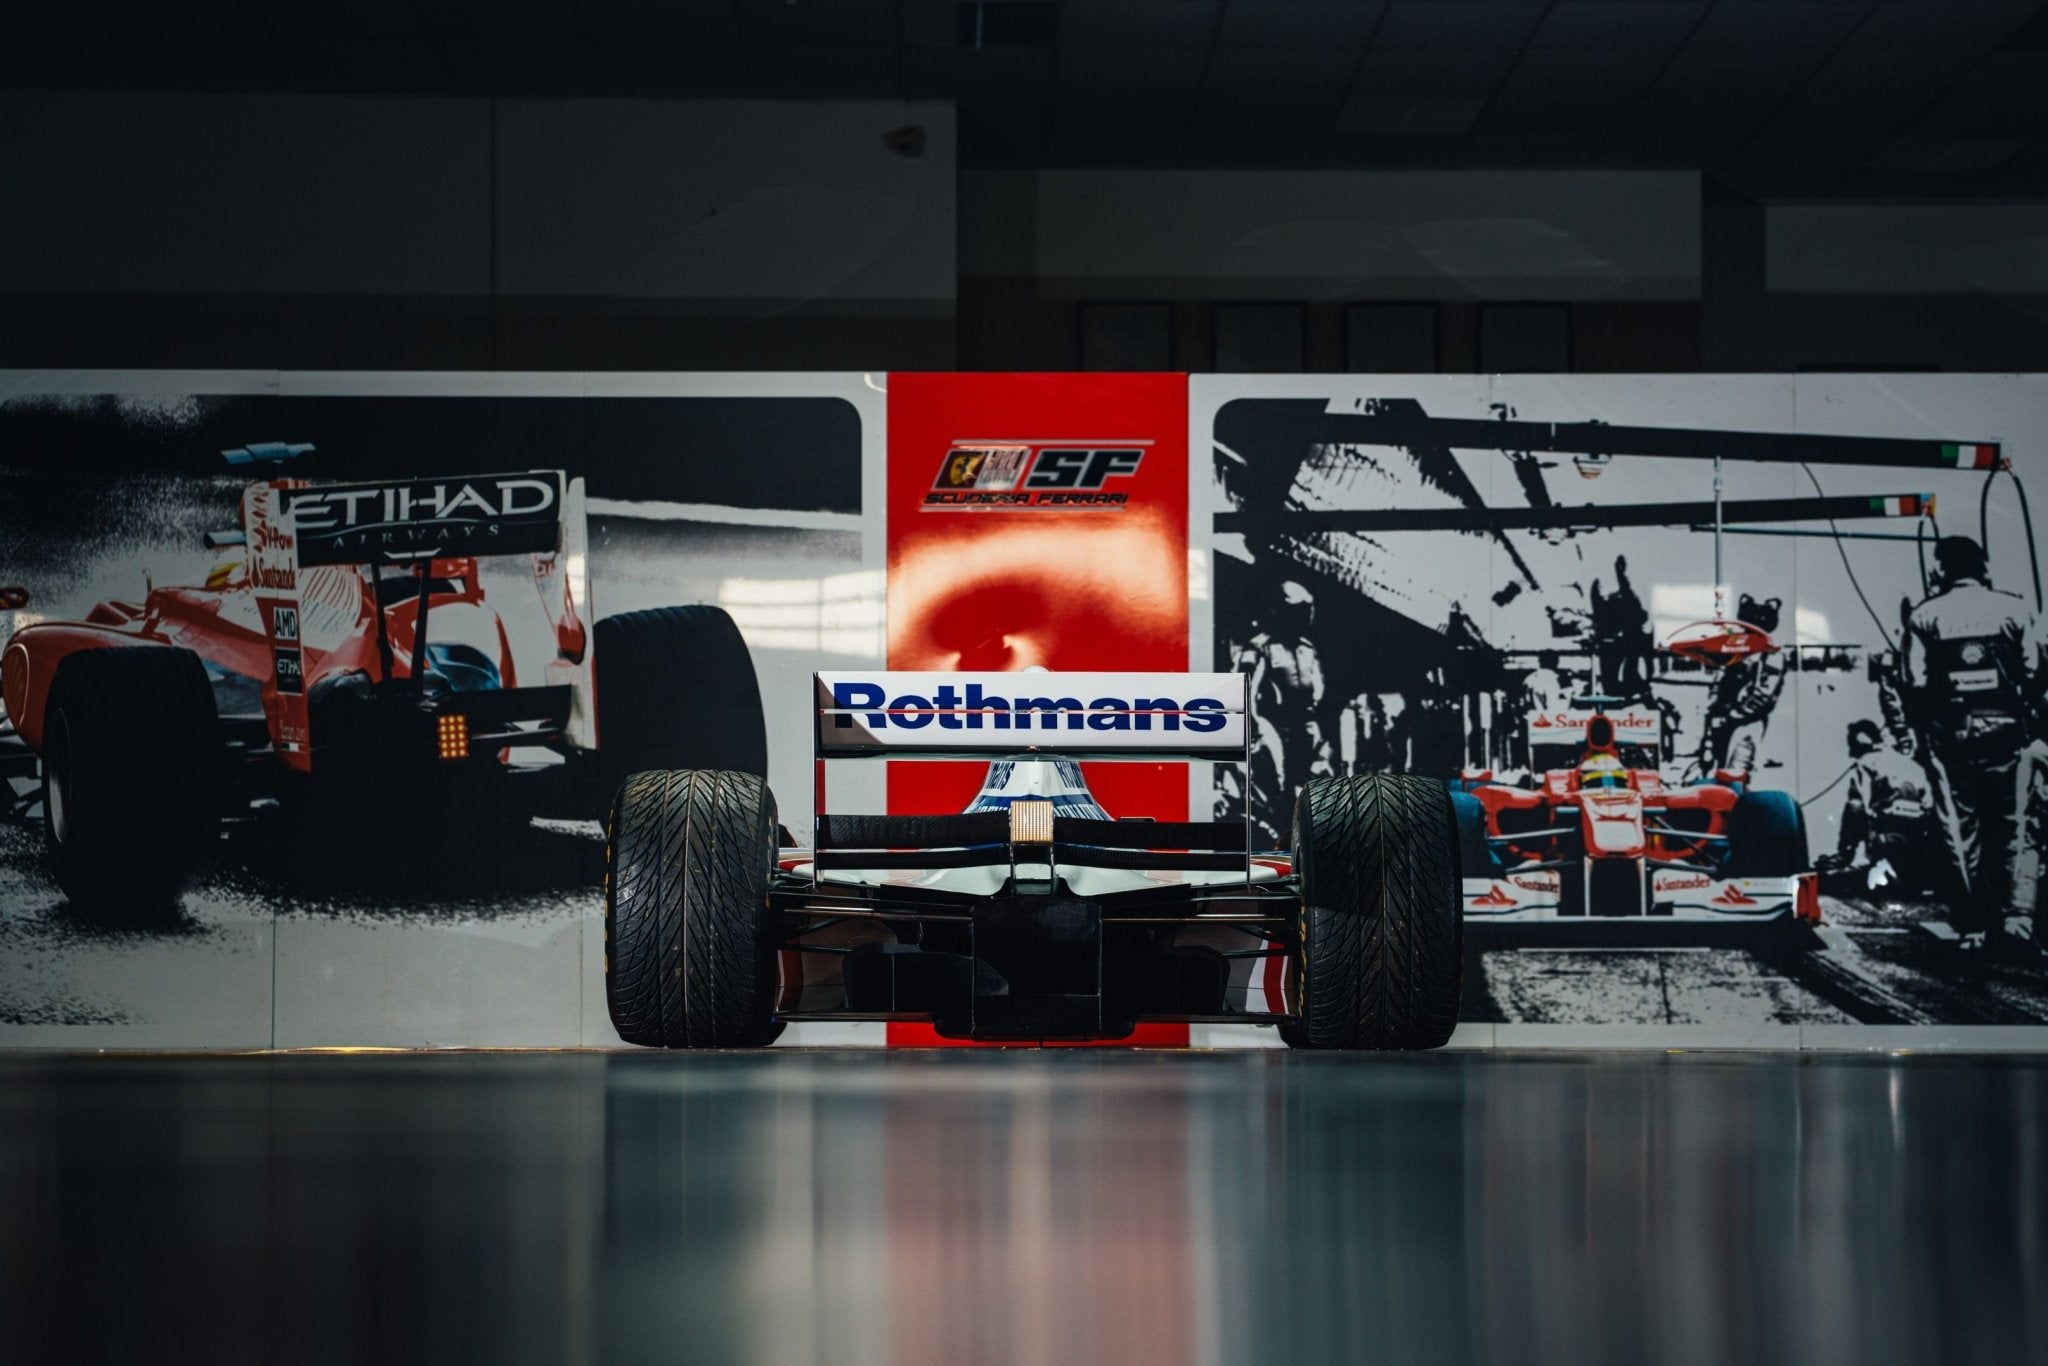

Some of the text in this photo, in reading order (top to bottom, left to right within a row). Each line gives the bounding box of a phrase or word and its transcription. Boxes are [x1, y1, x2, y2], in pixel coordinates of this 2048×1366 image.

[289, 480, 555, 528] ETIHAD
[923, 493, 1129, 505] SCUDERIA FERRARI
[332, 524, 499, 549] AIRWAYS
[275, 609, 296, 637] AMD
[833, 683, 1228, 733] Rothmans
[1555, 712, 1654, 729] Sannder
